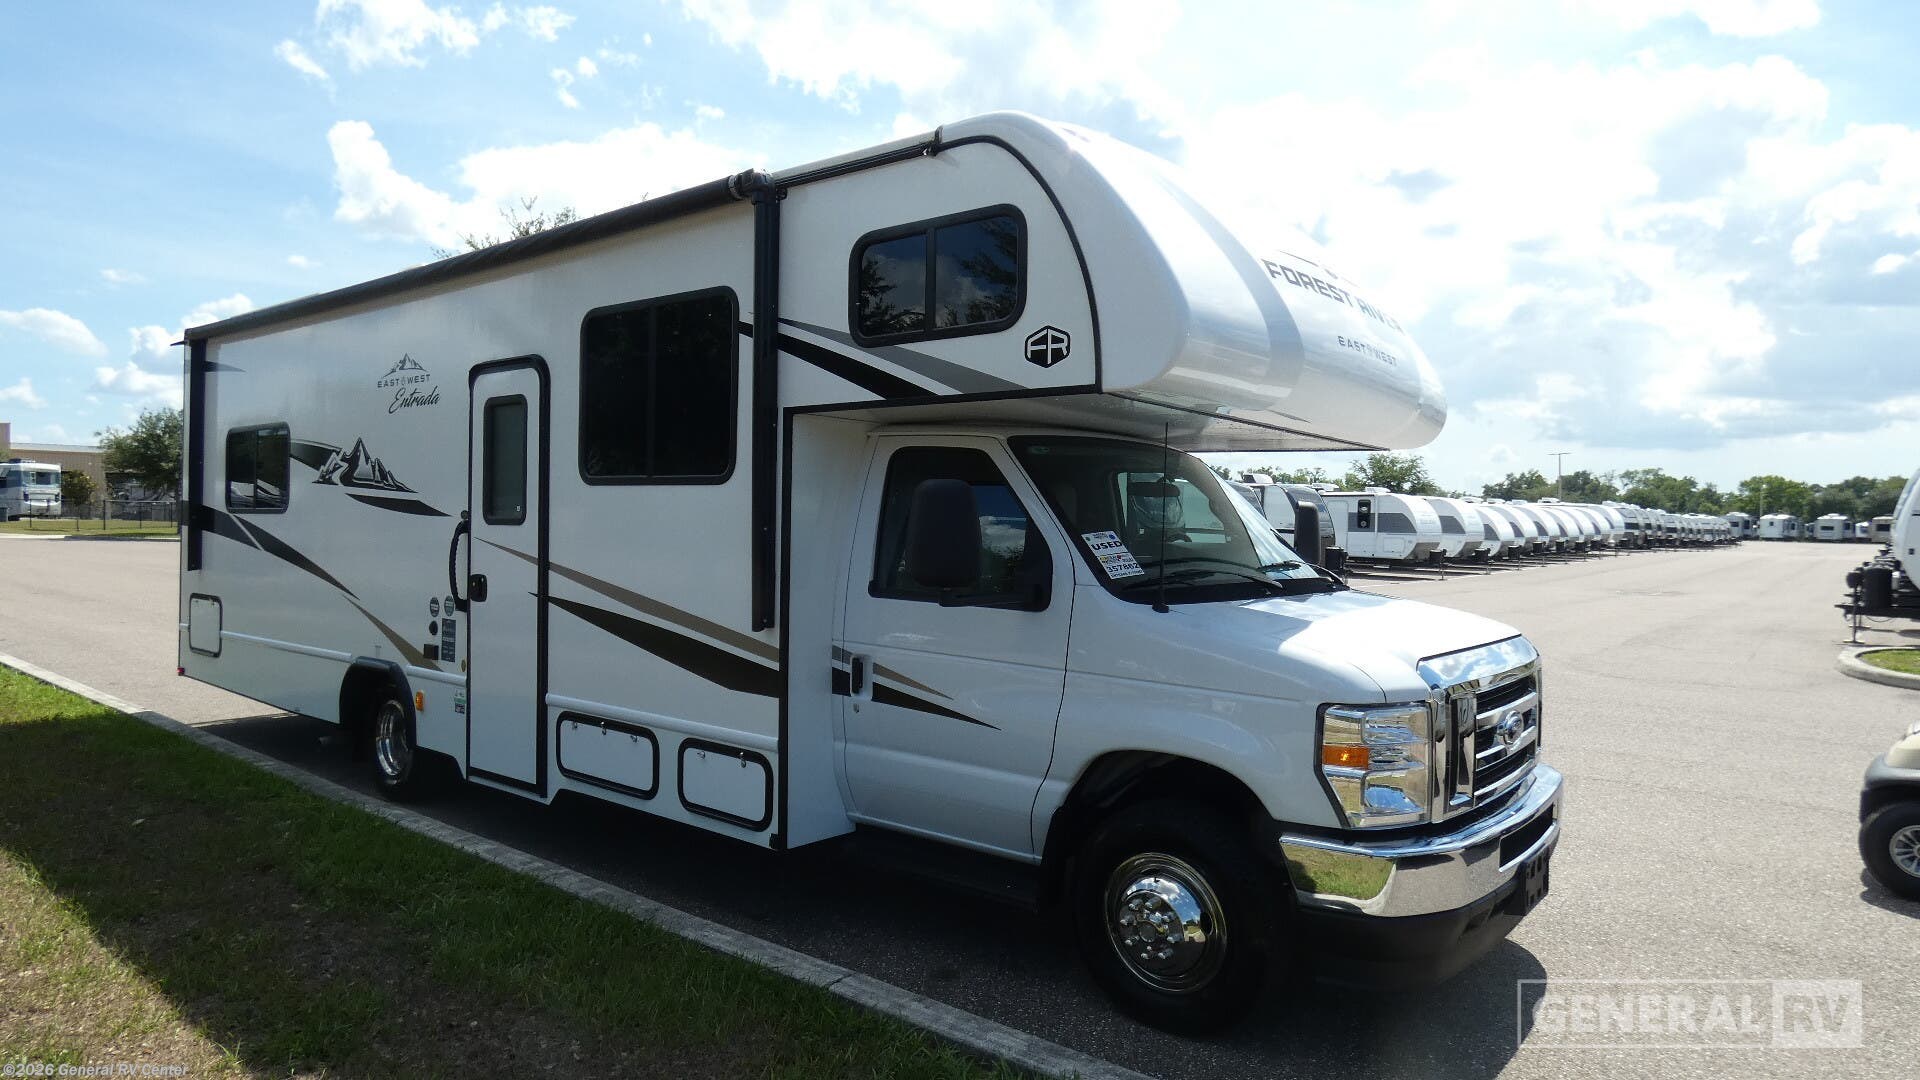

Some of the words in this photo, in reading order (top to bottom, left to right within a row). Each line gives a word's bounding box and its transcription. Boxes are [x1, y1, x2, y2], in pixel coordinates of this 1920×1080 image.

[1260, 258, 1353, 307] FOREST
[1337, 335, 1365, 353] EAST
[1374, 348, 1397, 366] WEST
[377, 378, 399, 387] EAST
[407, 373, 430, 384] WEST
[388, 385, 440, 414] Entrada
[1091, 541, 1122, 550] USED
